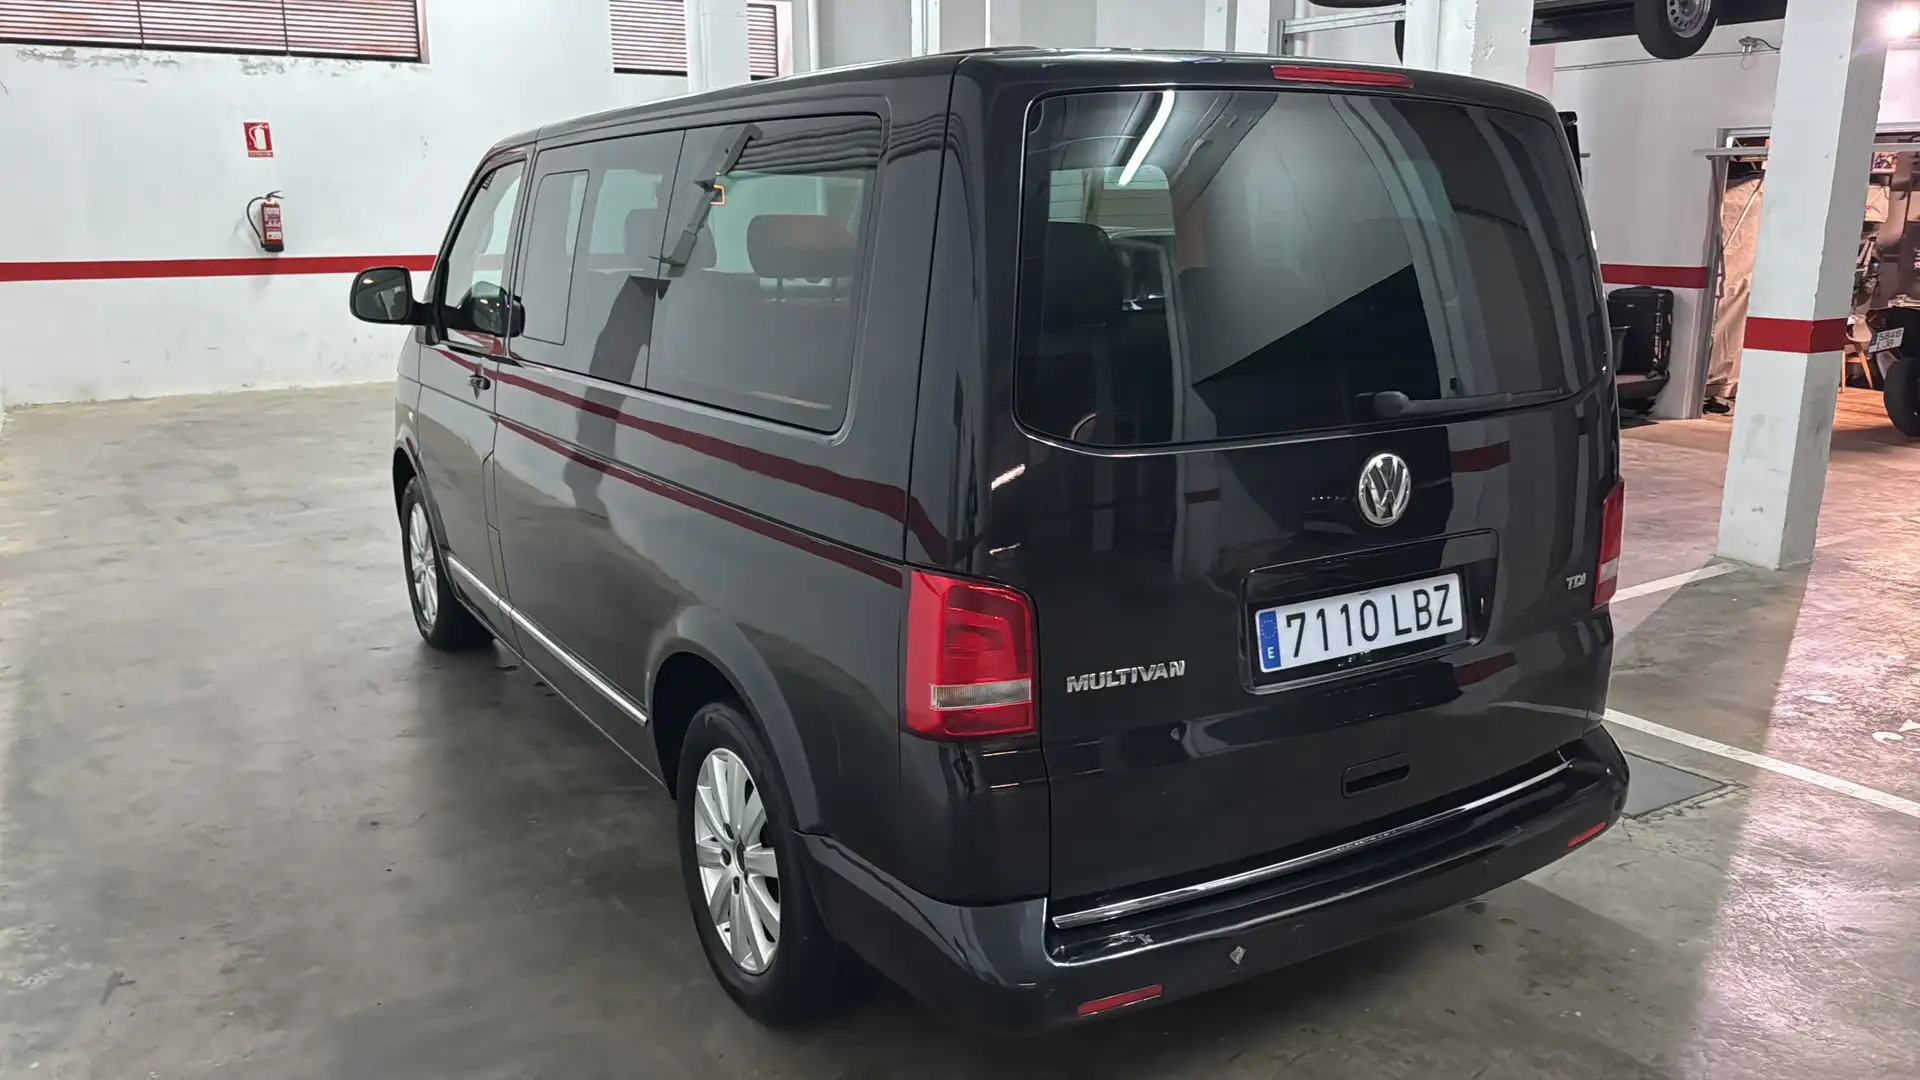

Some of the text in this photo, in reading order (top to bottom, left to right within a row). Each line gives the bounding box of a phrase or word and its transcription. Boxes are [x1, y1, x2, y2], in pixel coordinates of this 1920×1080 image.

[1566, 572, 1587, 590] TDI
[1286, 583, 1453, 658] 7110 LBZ
[1267, 646, 1275, 659] E
[1066, 660, 1185, 693] MULTIVAN
